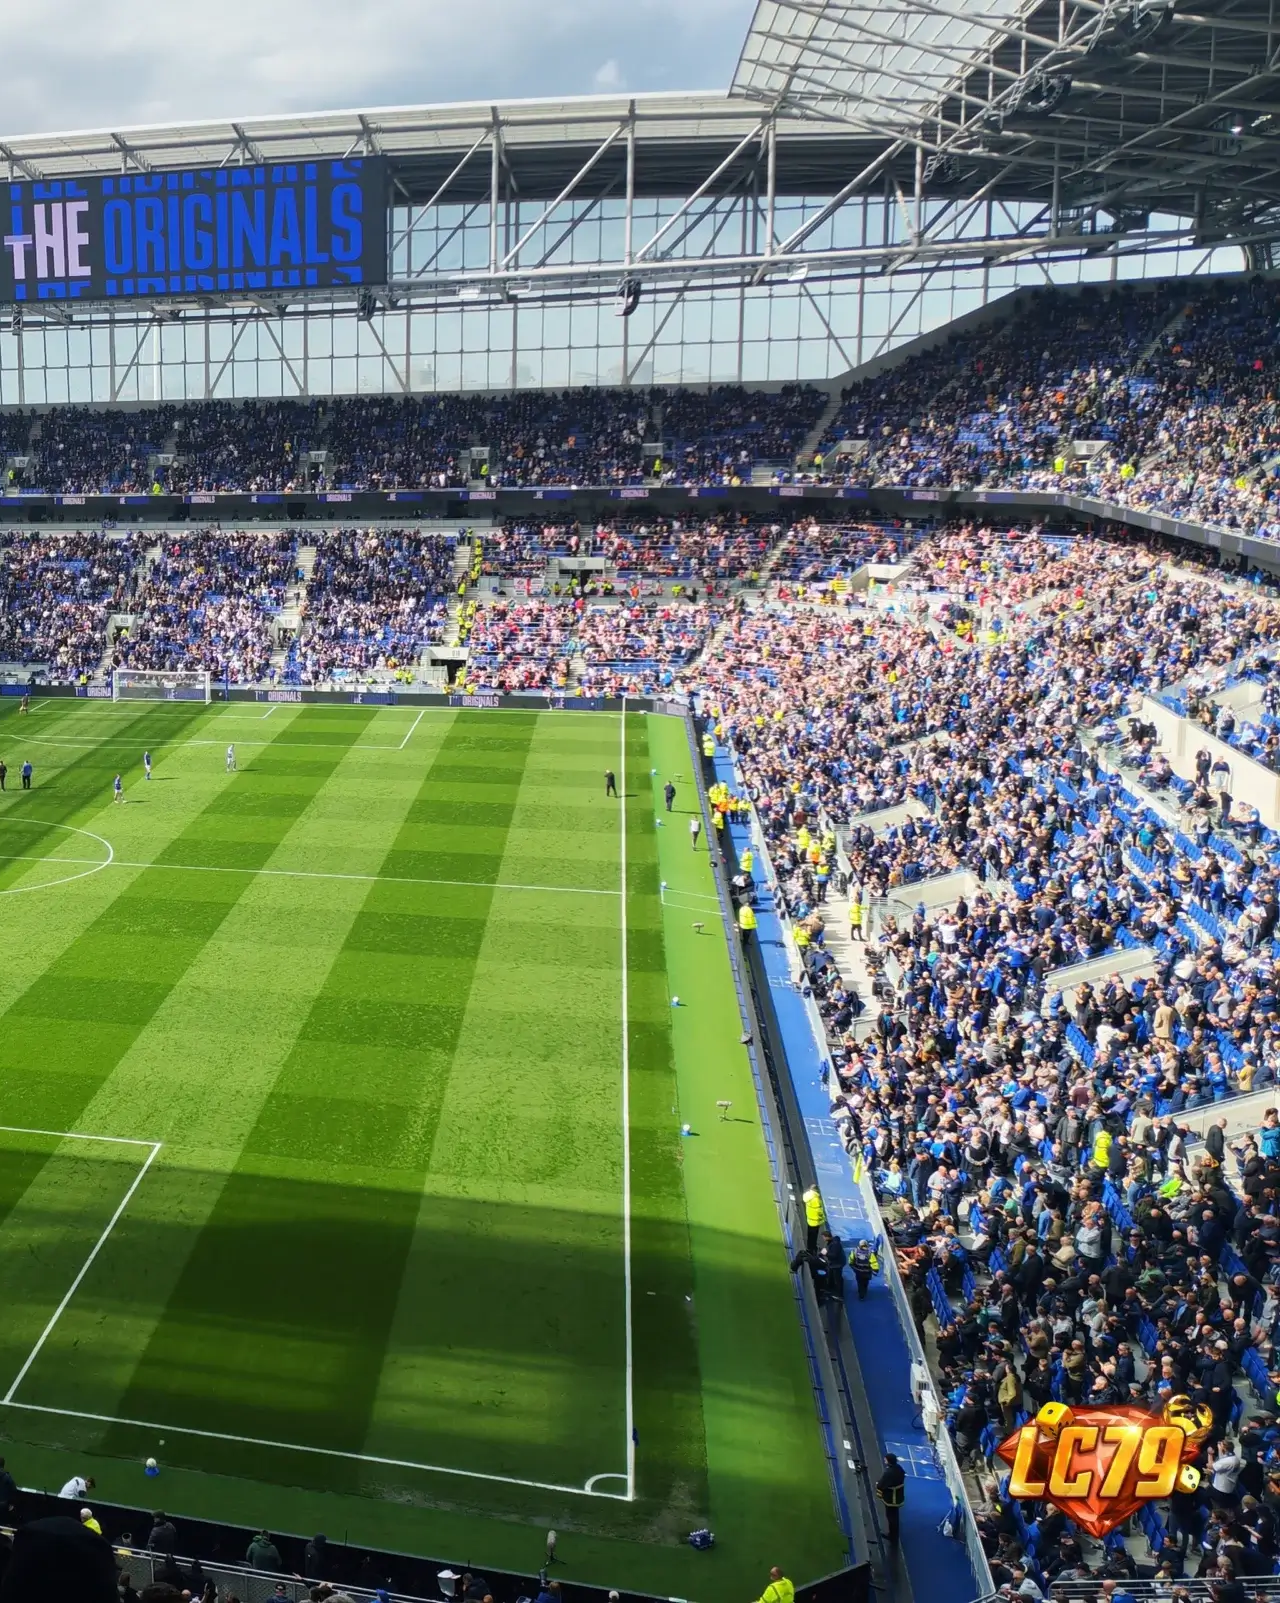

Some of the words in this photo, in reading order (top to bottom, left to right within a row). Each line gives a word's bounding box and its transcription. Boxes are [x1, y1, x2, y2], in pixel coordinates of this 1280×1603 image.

[4, 201, 92, 281] THE
[103, 182, 363, 275] ORIGINALS
[267, 691, 302, 703] ORIGINALS
[462, 695, 499, 708] ORIGINALS
